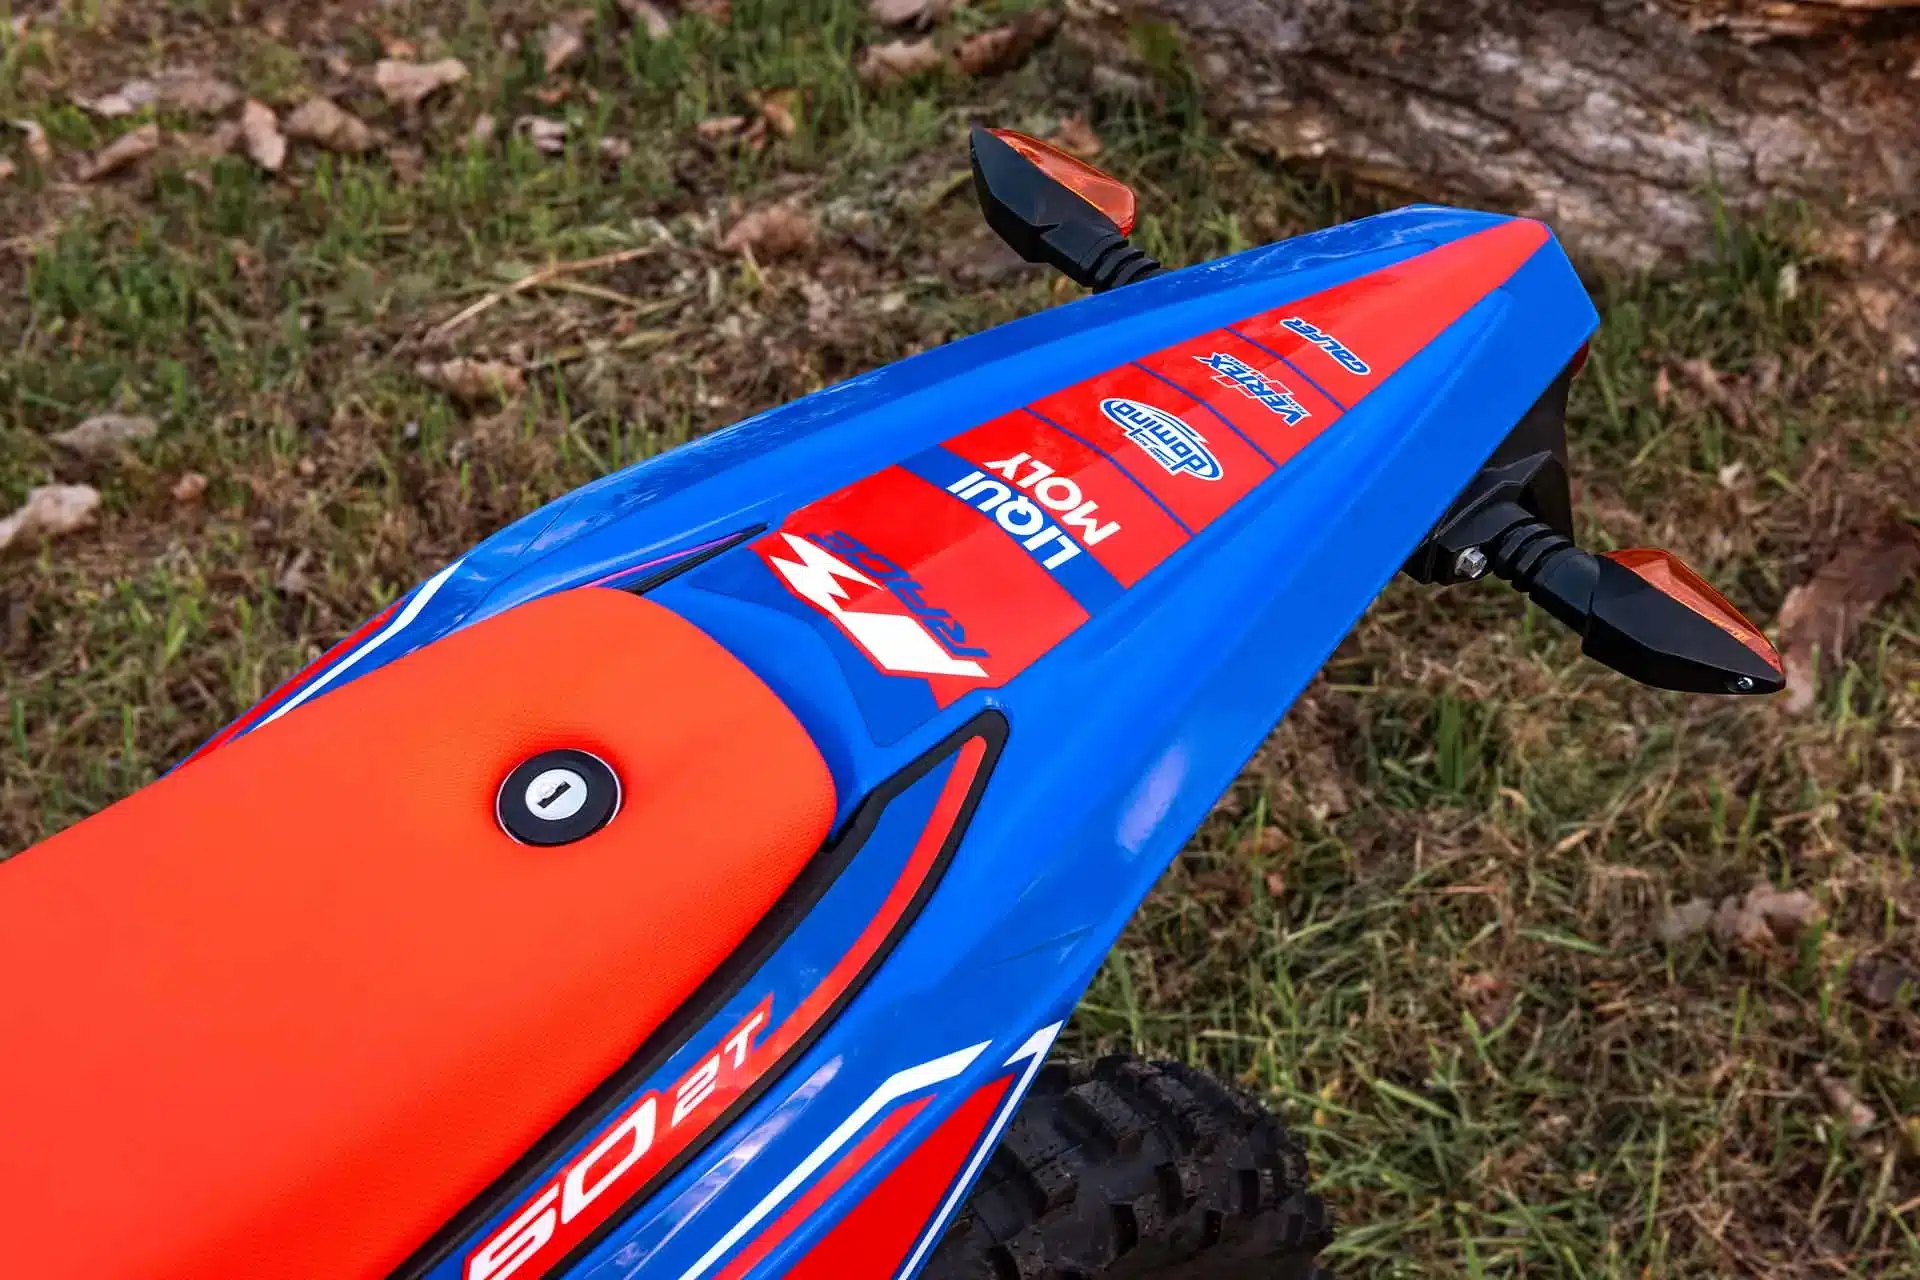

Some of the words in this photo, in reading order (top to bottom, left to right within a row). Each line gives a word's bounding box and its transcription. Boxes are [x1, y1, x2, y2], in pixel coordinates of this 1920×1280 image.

[1112, 402, 1209, 472] domino
[1196, 352, 1304, 426] VERTEX
[945, 470, 1082, 570] LIQUI
[983, 451, 1122, 546] MOLY
[804, 530, 990, 658] RACE
[671, 1011, 765, 1128] 2T
